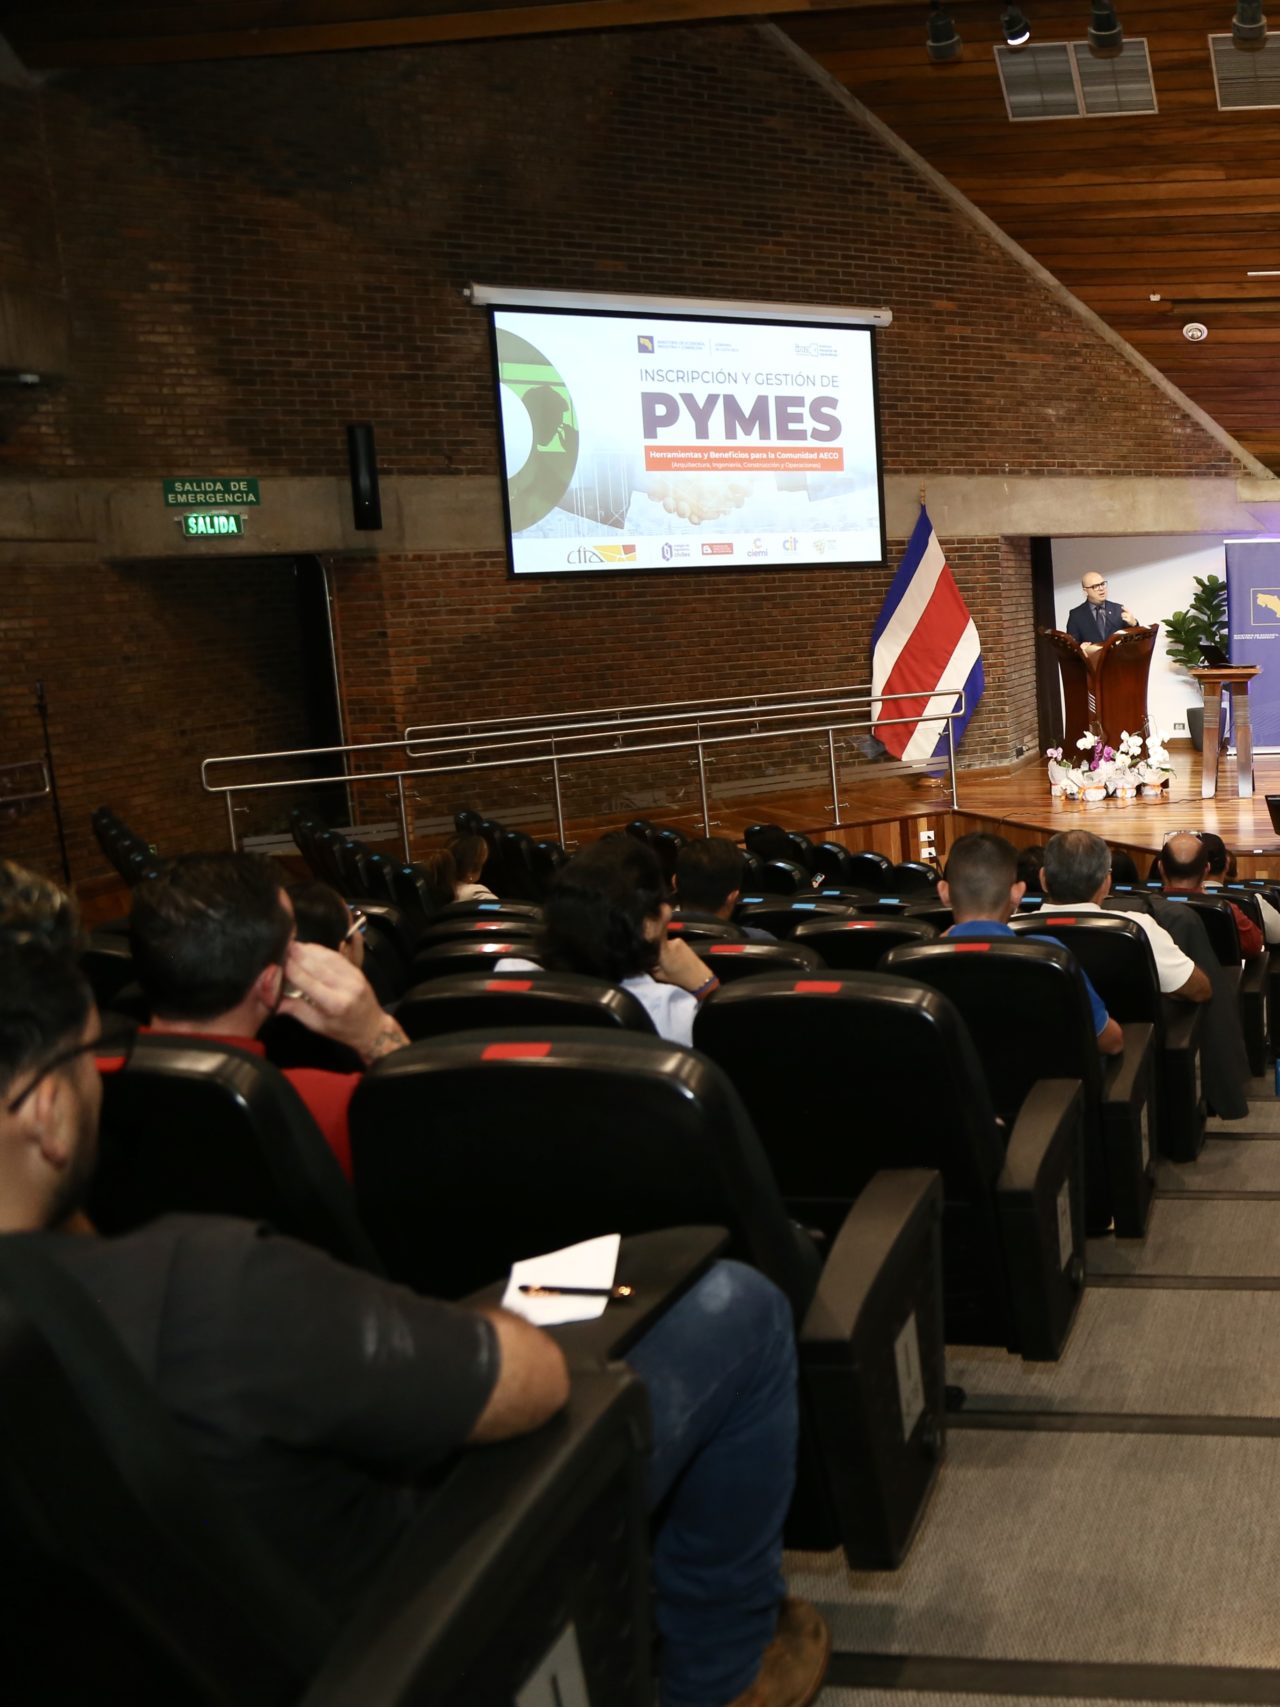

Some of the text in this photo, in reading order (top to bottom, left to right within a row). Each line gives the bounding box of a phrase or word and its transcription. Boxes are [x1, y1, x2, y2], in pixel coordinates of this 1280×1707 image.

[639, 368, 840, 388] INSCRIPCIÓN Y GESTIÓN DE
[641, 391, 842, 442] PYMES
[650, 450, 702, 459] Herramientas
[710, 451, 749, 459] Beneficios
[777, 451, 818, 460] Comunidad
[175, 482, 248, 491] SALIDA DE
[168, 493, 256, 504] EMERGENCIA
[188, 516, 238, 534] SALIDA
[783, 536, 798, 551] cit
